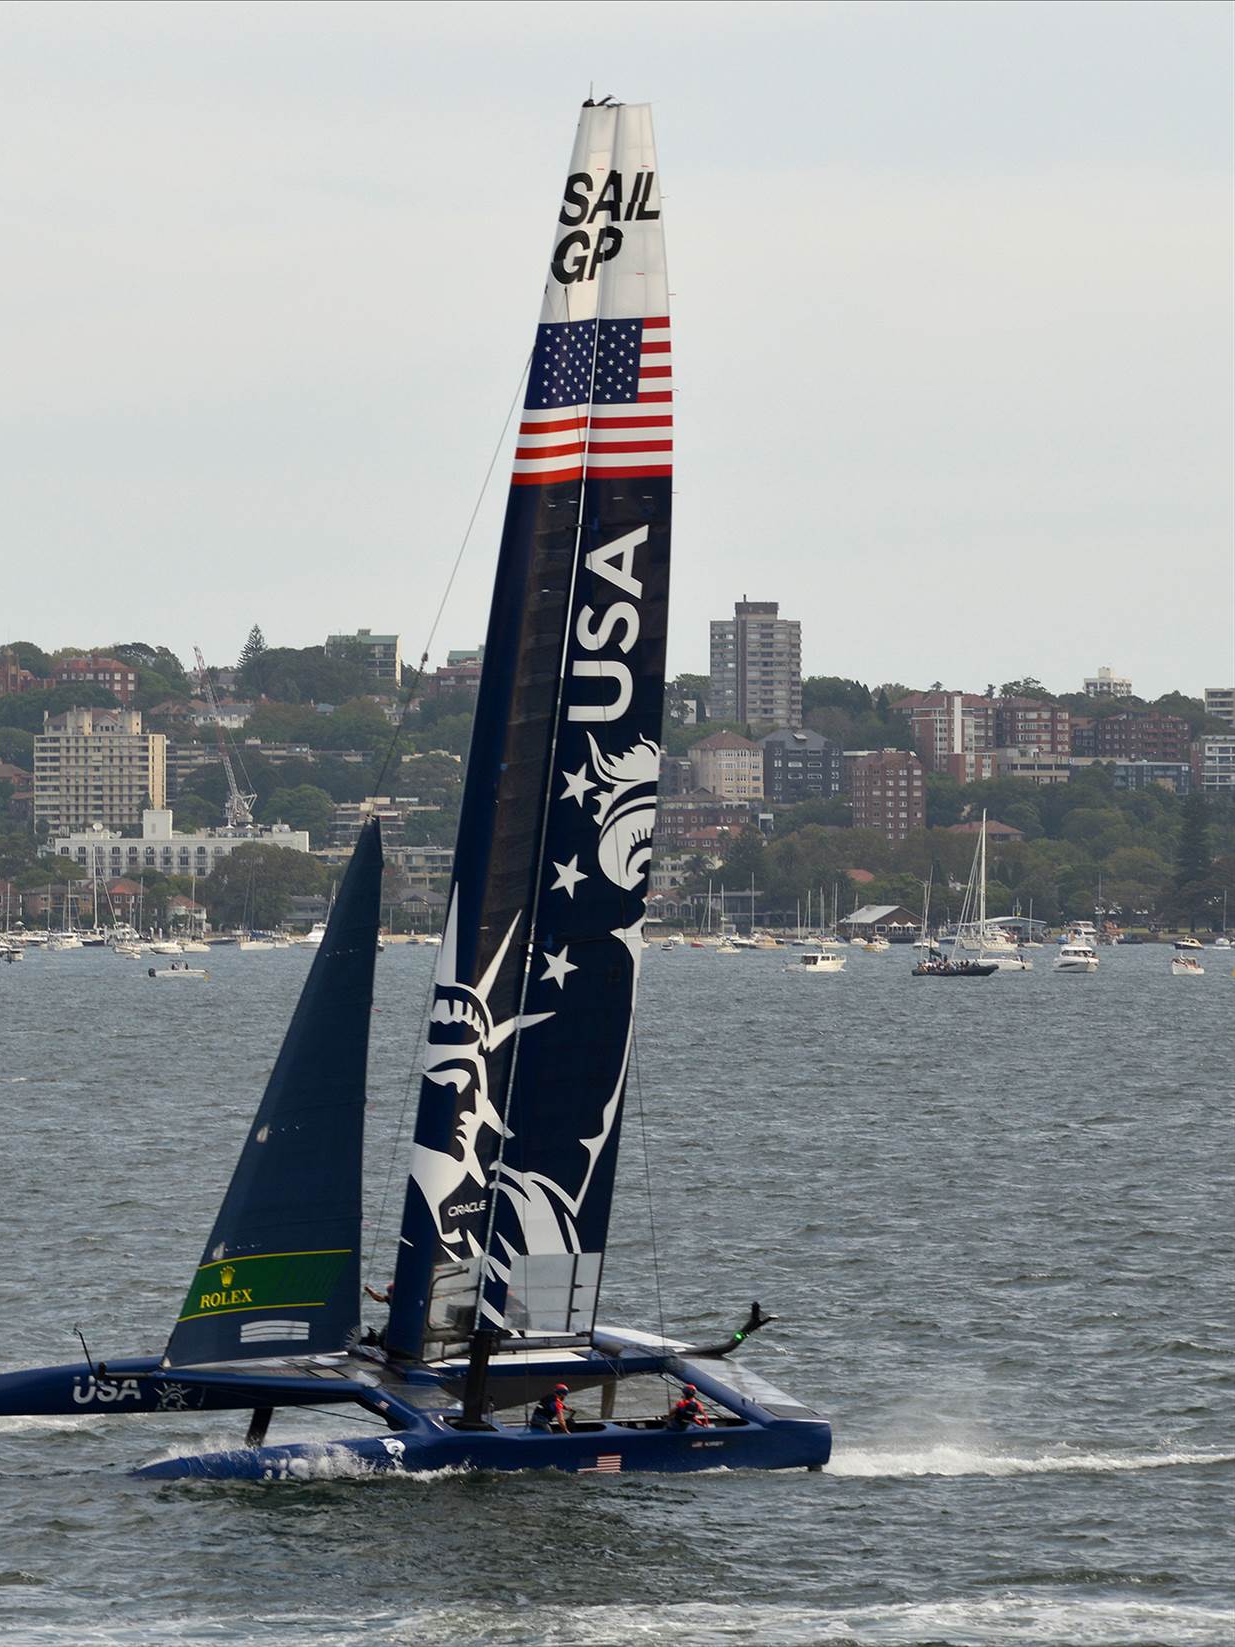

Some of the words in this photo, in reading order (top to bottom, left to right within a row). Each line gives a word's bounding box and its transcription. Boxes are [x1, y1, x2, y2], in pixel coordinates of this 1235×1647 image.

[559, 170, 661, 227] SAIL
[551, 225, 624, 285] GP
[567, 524, 649, 722] USA
[447, 1199, 487, 1217] ORACLE
[200, 1288, 253, 1309] ROLEX
[73, 1375, 141, 1405] USA
